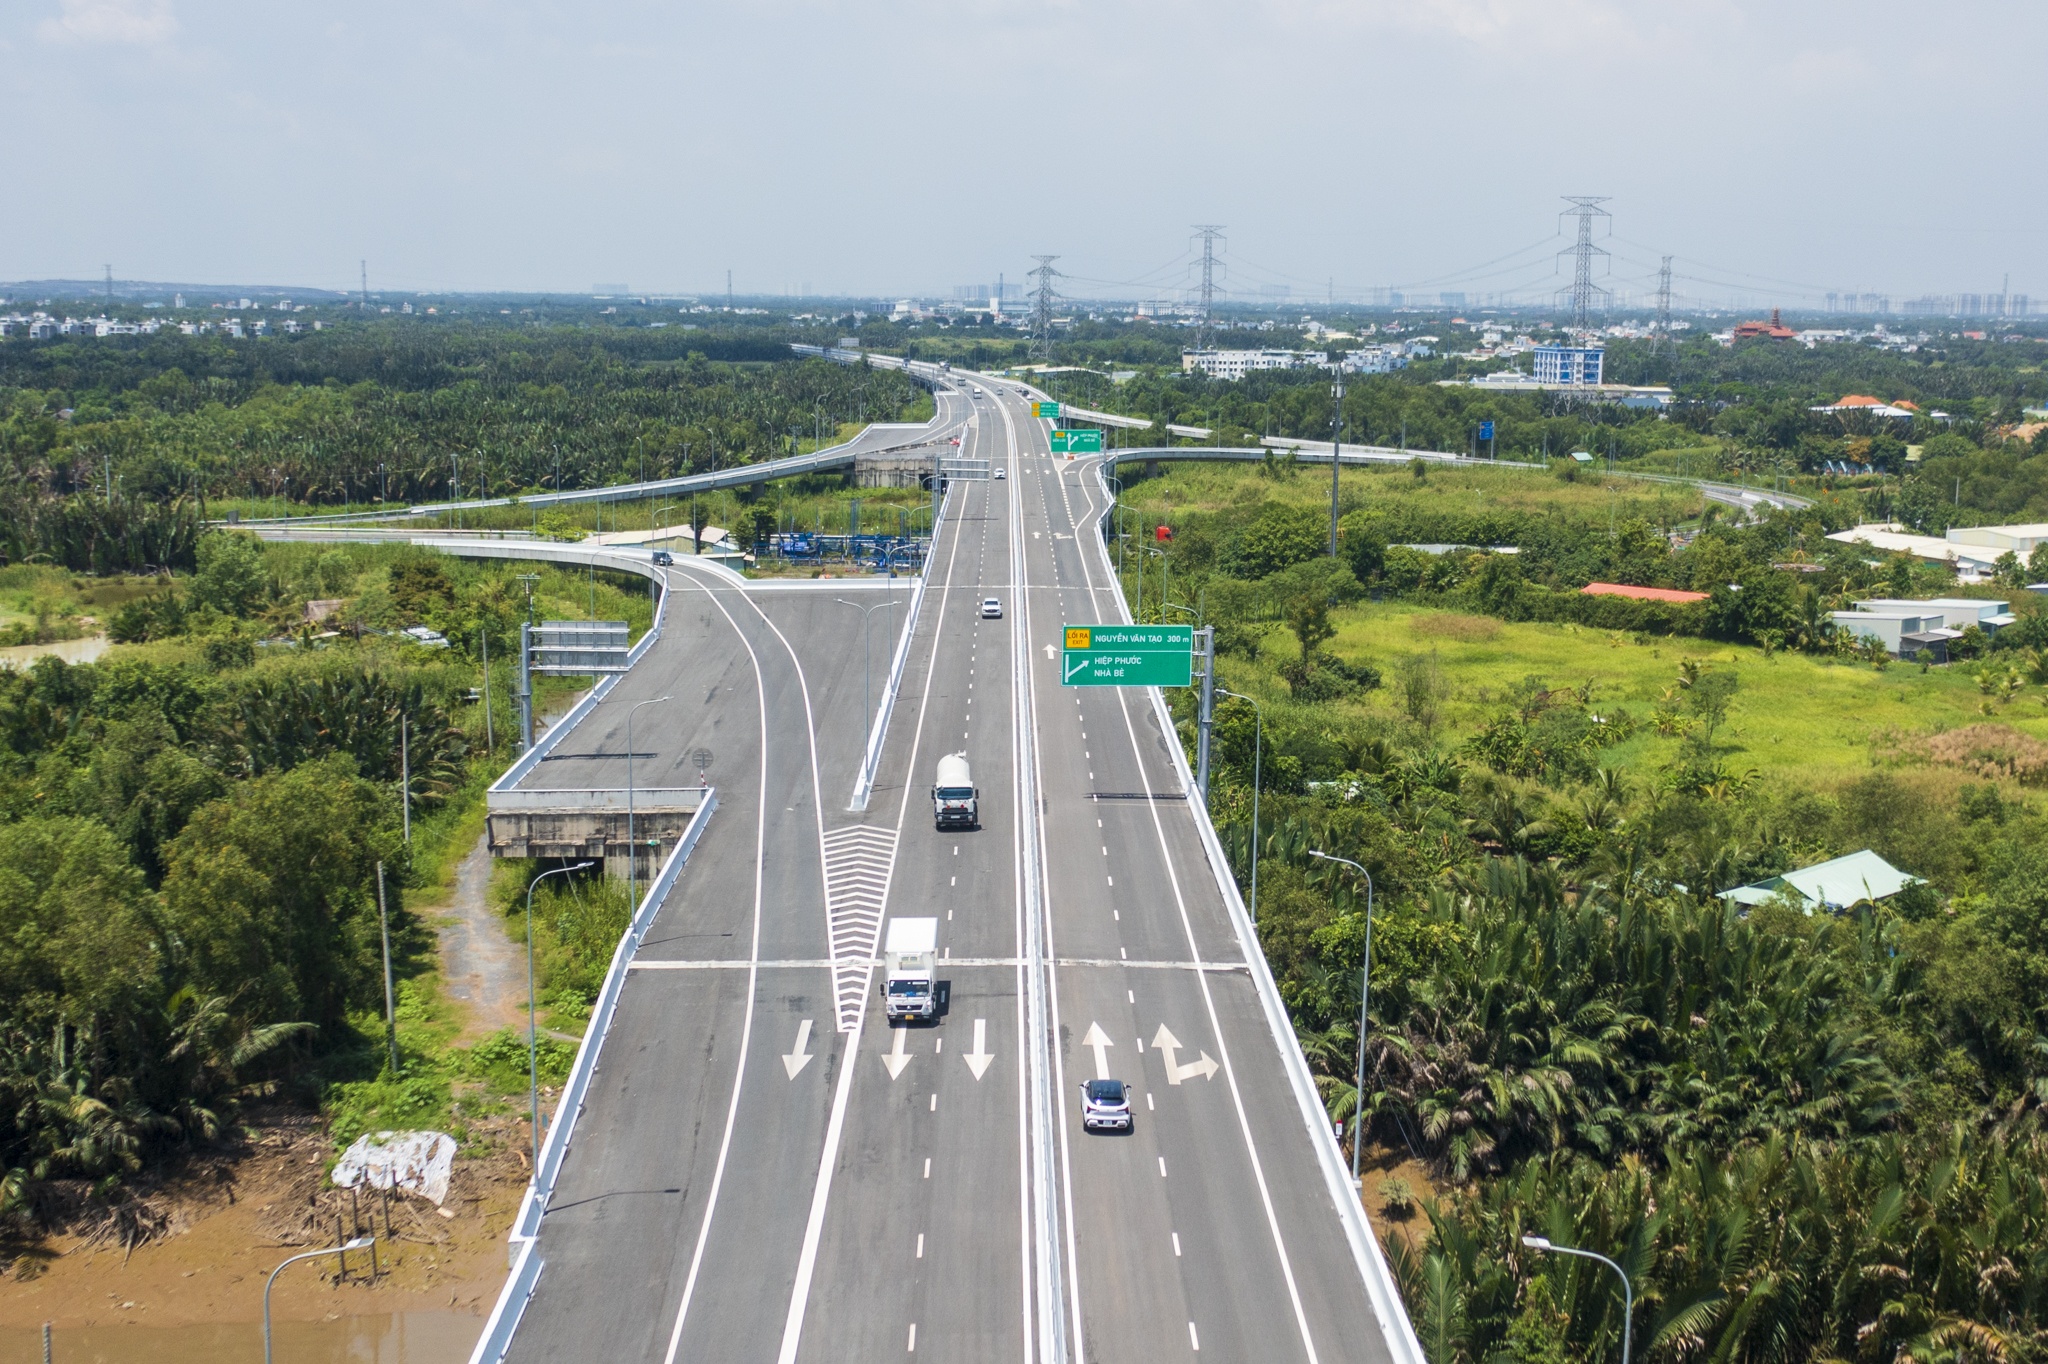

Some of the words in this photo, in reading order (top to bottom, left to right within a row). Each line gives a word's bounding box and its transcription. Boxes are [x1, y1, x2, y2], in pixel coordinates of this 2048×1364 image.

[1067, 630, 1078, 639] LỐI
[1130, 633, 1146, 643] VĂN
[1147, 635, 1163, 644] TẠO
[1167, 635, 1181, 643] 300
[1094, 655, 1113, 666] HIỆP
[1114, 654, 1142, 665] PHƯỚC
[1094, 667, 1112, 677] NHÀ
[1113, 667, 1125, 677] BÈ
